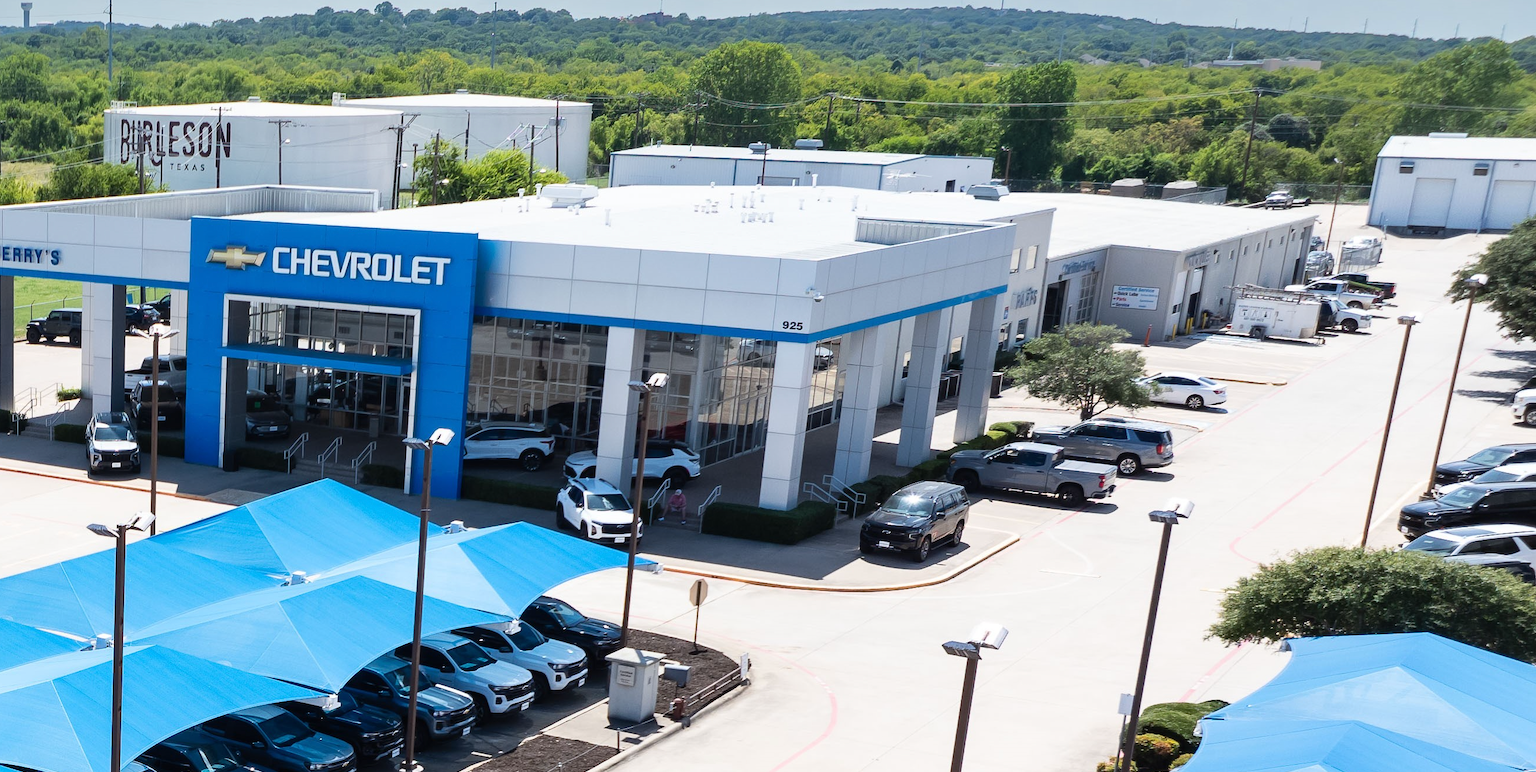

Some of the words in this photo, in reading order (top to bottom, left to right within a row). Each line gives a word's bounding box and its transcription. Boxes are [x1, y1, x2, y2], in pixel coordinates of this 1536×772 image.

[120, 118, 232, 167] BURLESON
[170, 162, 206, 172] TEXAS
[272, 246, 452, 286] CHEVROLET
[782, 320, 804, 331] 925
